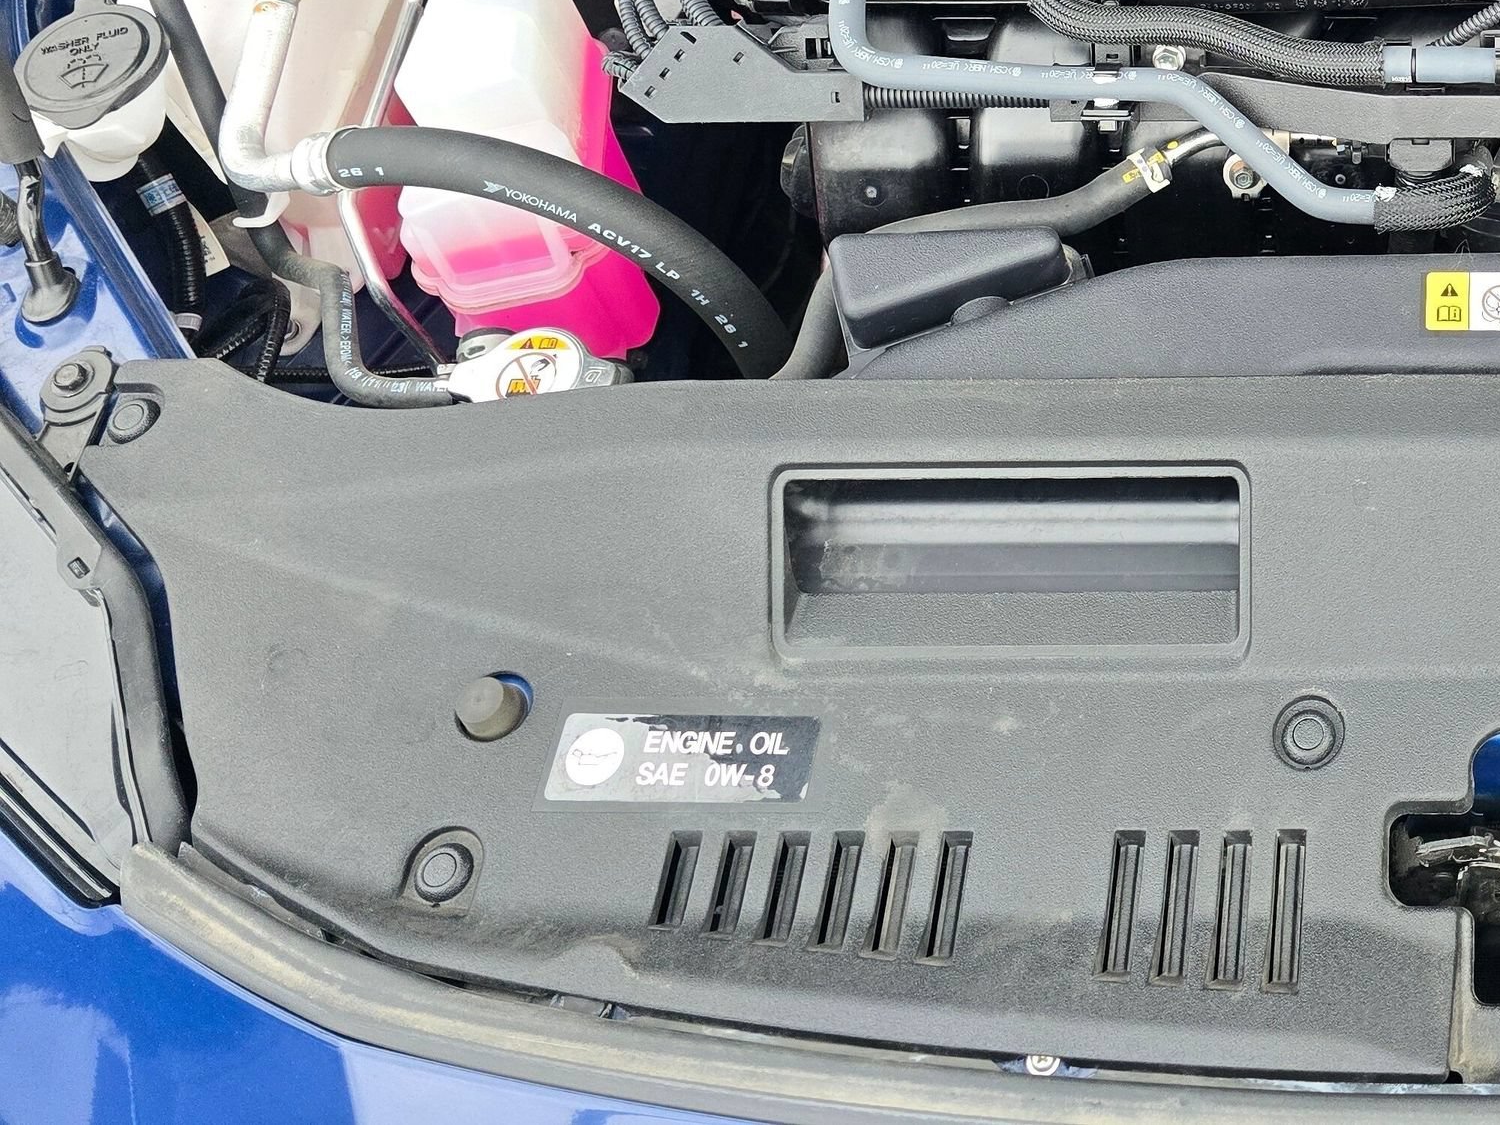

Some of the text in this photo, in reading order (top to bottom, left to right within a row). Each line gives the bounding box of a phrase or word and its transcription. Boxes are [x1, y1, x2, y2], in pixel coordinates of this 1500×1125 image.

[41, 26, 129, 55] WASHER FLUID
[69, 42, 99, 56] ONLY
[338, 166, 748, 348] 26 1 YOKOHAMA ACV17 LP 1H 26 1
[749, 732, 790, 755] OIL
[635, 761, 775, 787] SAE 0W-8
